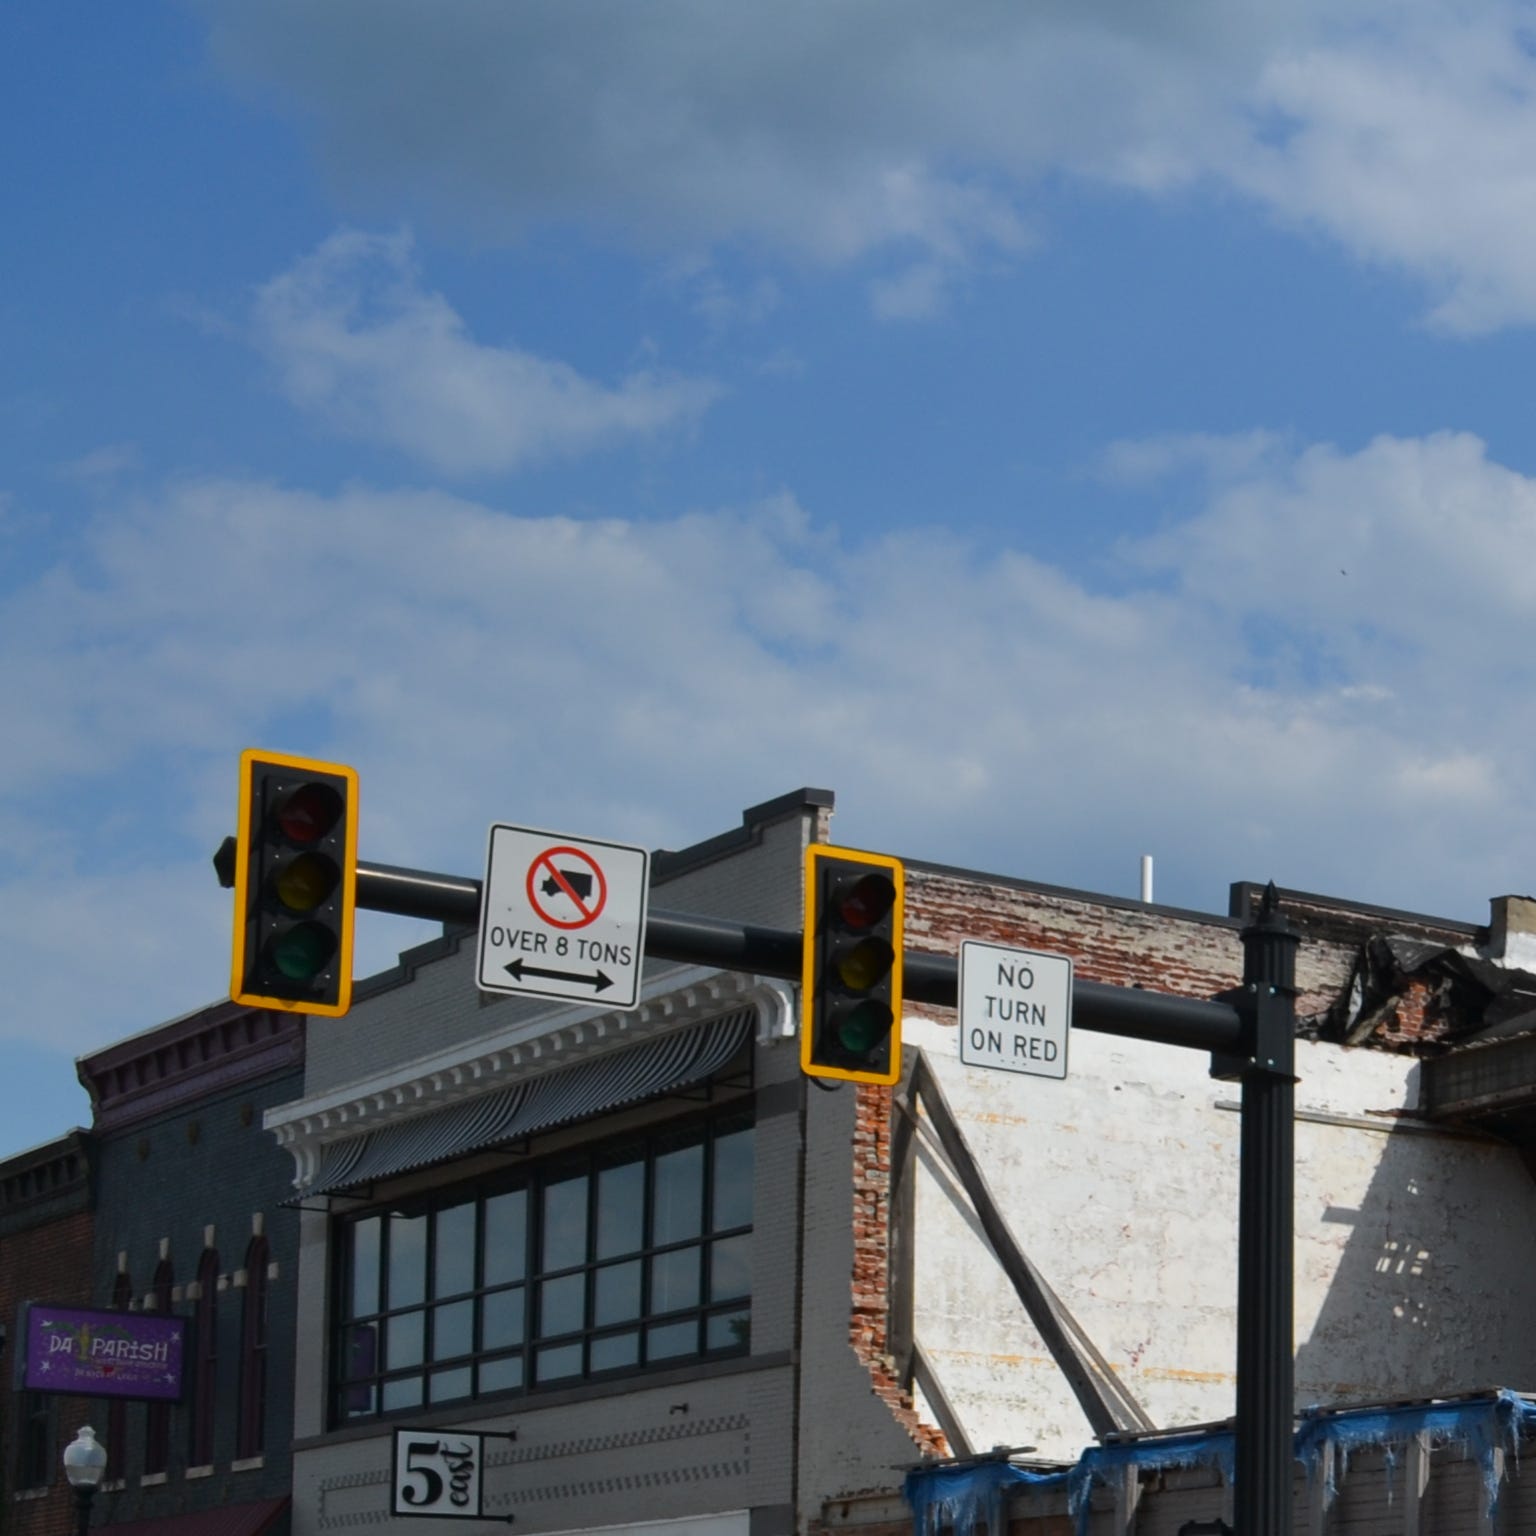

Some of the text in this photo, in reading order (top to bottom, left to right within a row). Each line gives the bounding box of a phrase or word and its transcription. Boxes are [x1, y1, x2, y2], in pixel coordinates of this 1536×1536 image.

[490, 926, 631, 966] OVER 8 TONS
[997, 963, 1034, 990] NO
[985, 995, 1046, 1027] TURN
[971, 1028, 1057, 1062] ON RED
[49, 1335, 73, 1354] DA
[402, 1440, 475, 1507] 5 east
